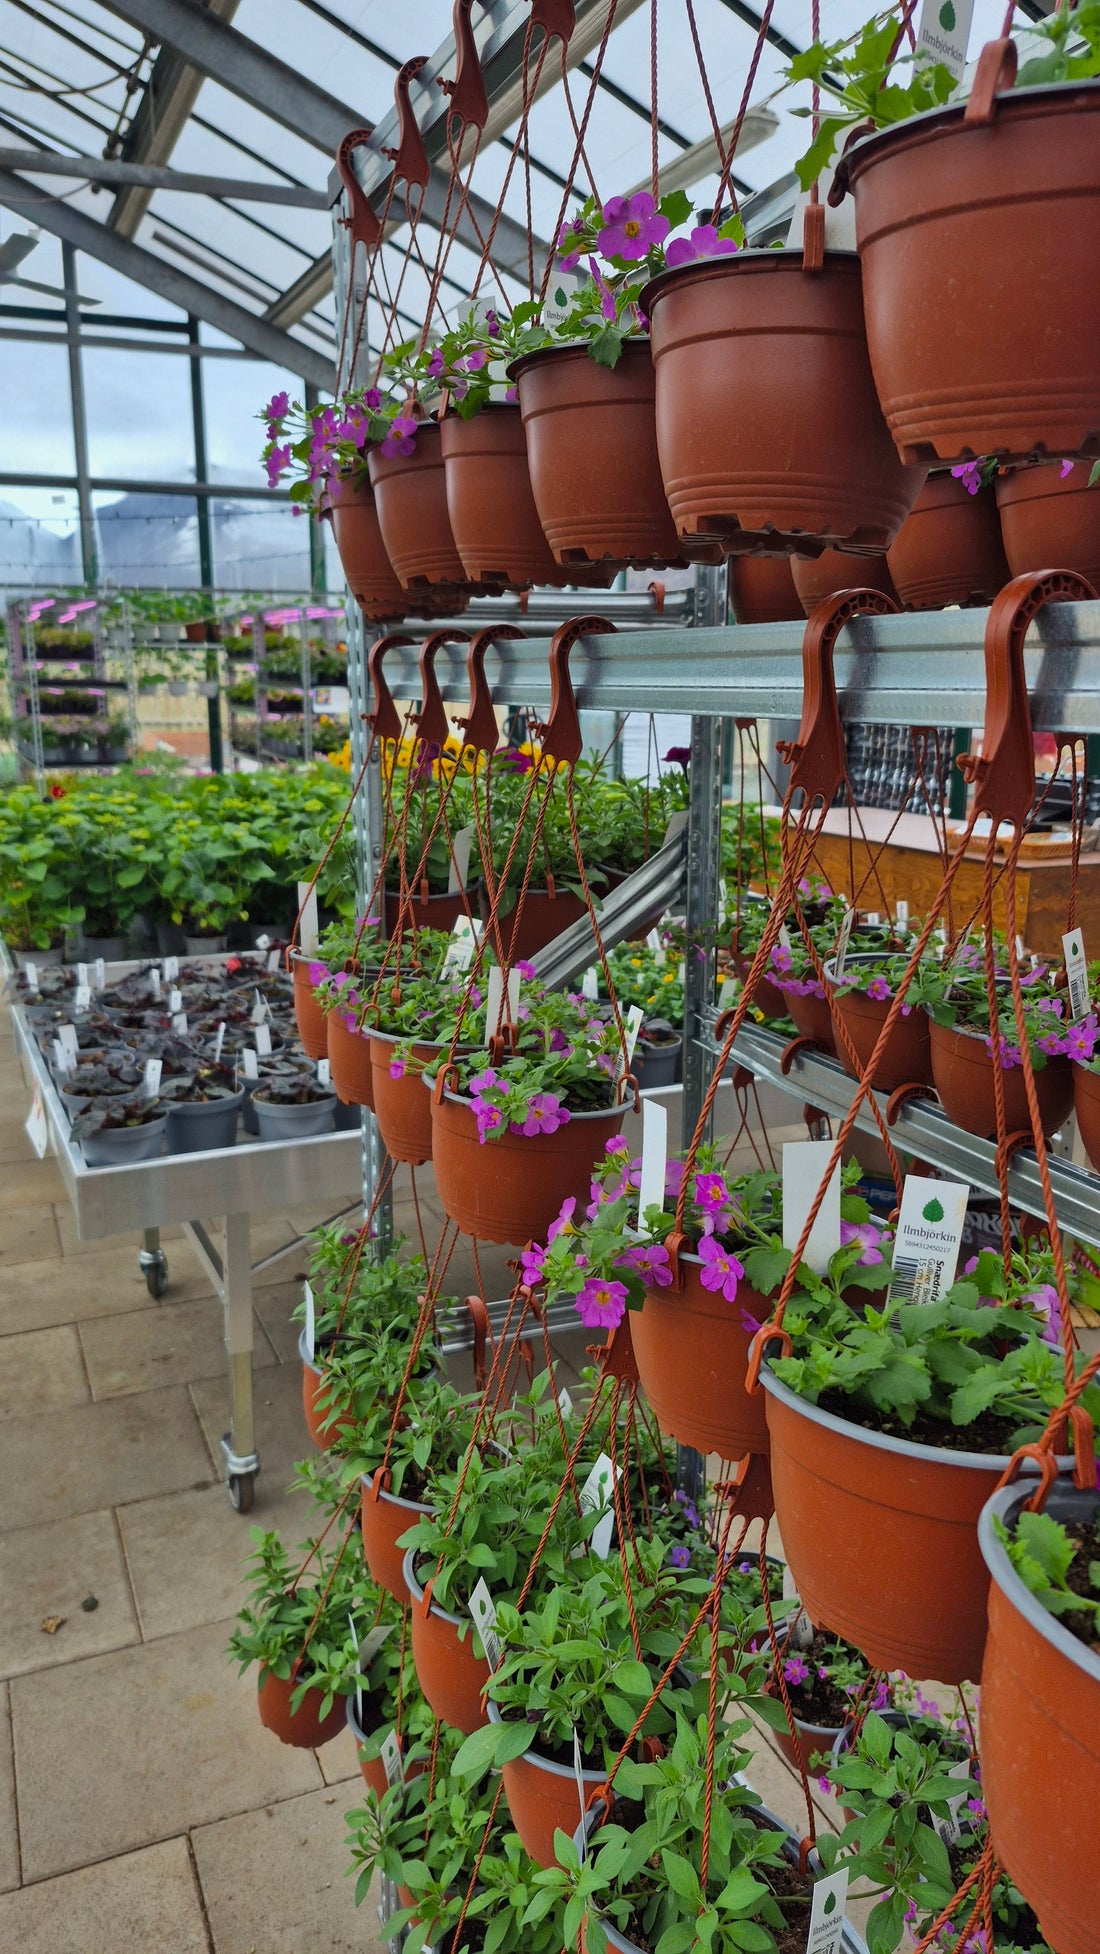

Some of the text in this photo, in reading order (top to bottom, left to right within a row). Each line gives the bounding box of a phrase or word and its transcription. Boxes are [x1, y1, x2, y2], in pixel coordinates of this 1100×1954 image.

[903, 1224, 957, 1243] Ilmbjörkin
[919, 1258, 927, 1267] 15
[916, 1268, 924, 1280] cm
